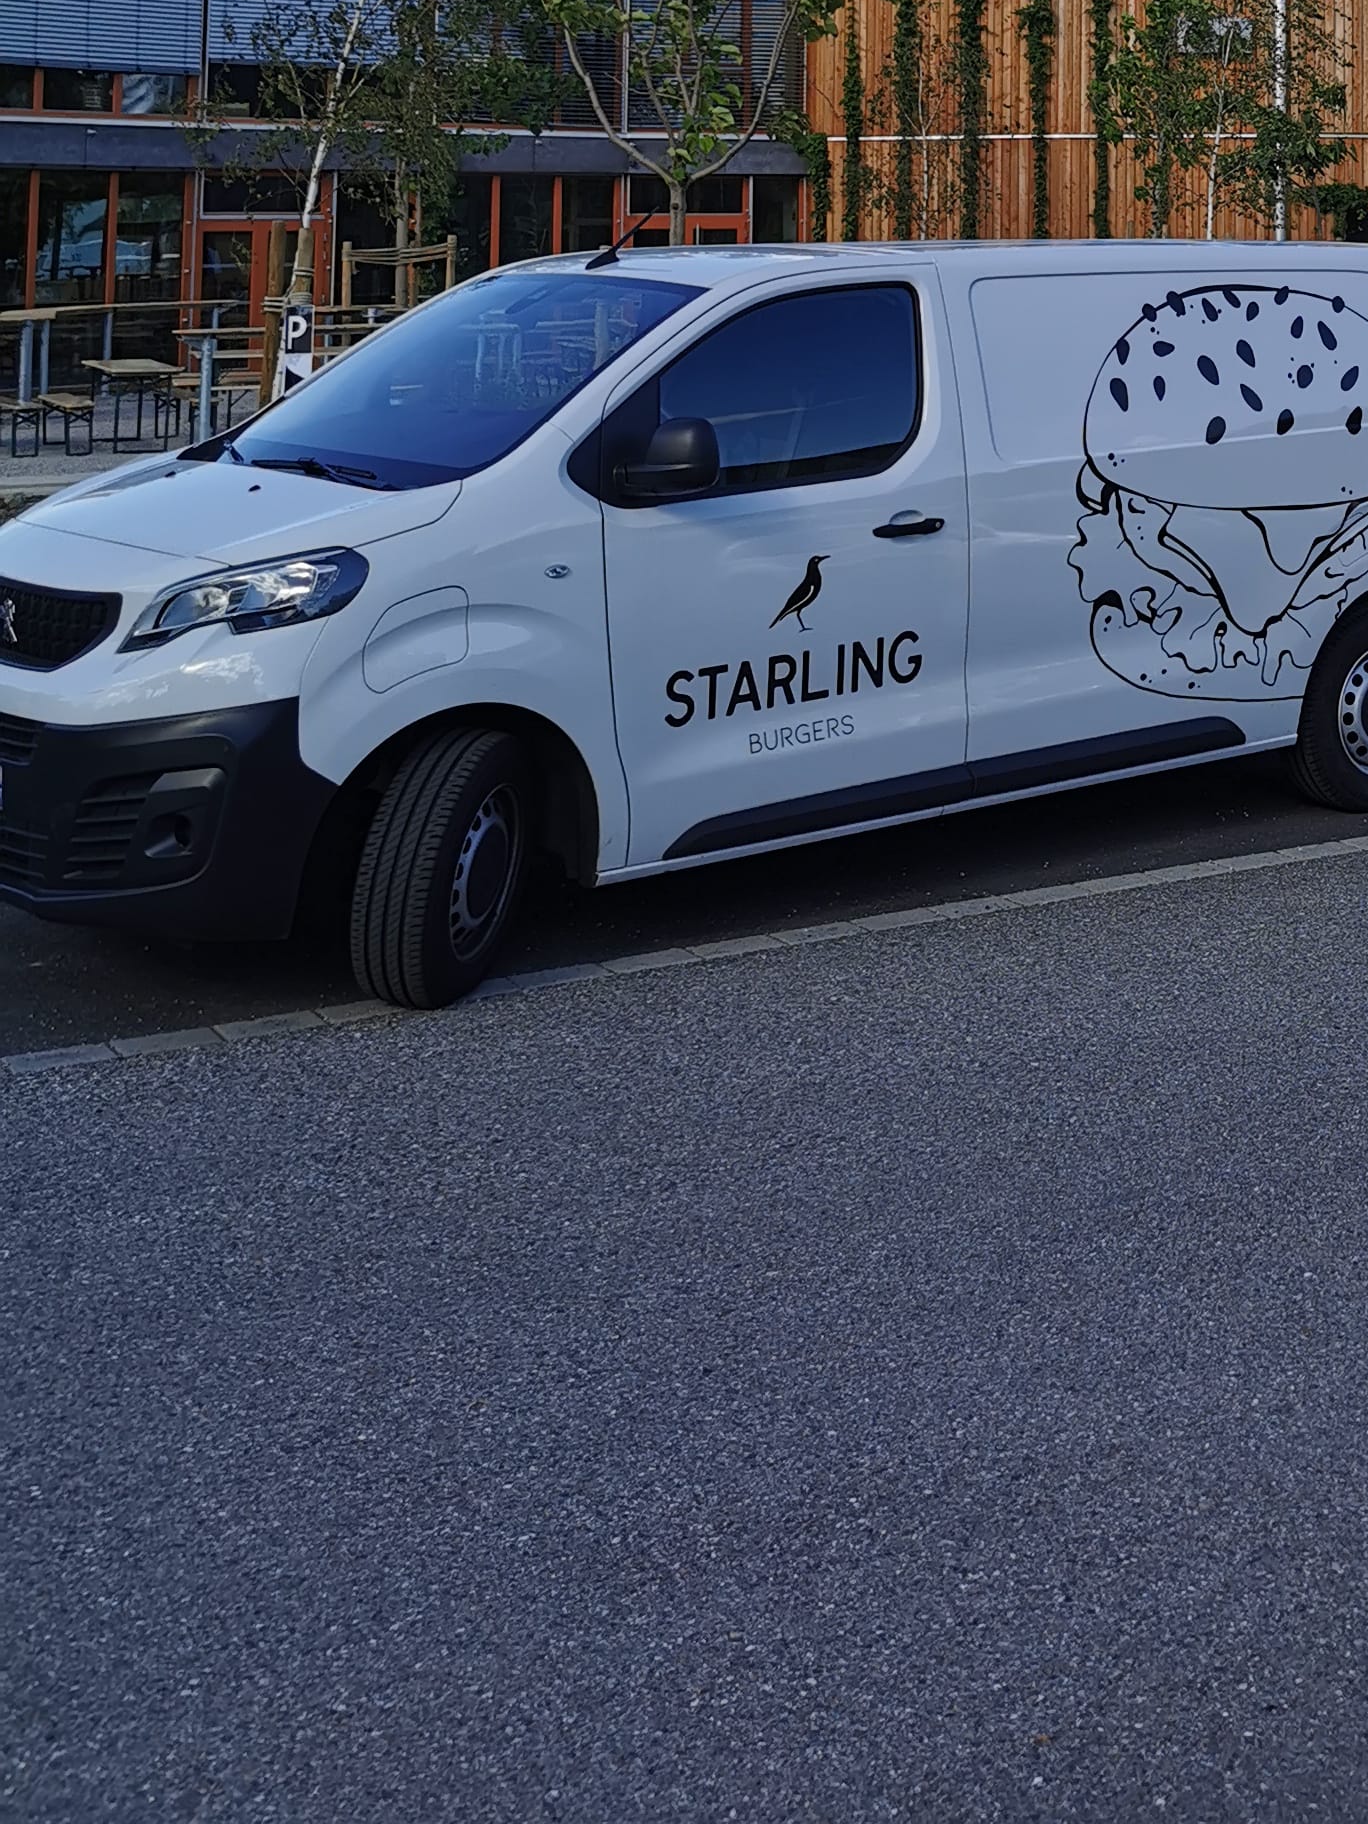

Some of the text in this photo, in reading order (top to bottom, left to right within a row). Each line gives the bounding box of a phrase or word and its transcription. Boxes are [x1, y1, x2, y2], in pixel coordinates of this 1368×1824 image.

[287, 315, 308, 350] P
[664, 630, 923, 727] STARLING
[748, 714, 855, 754] BURGERS
